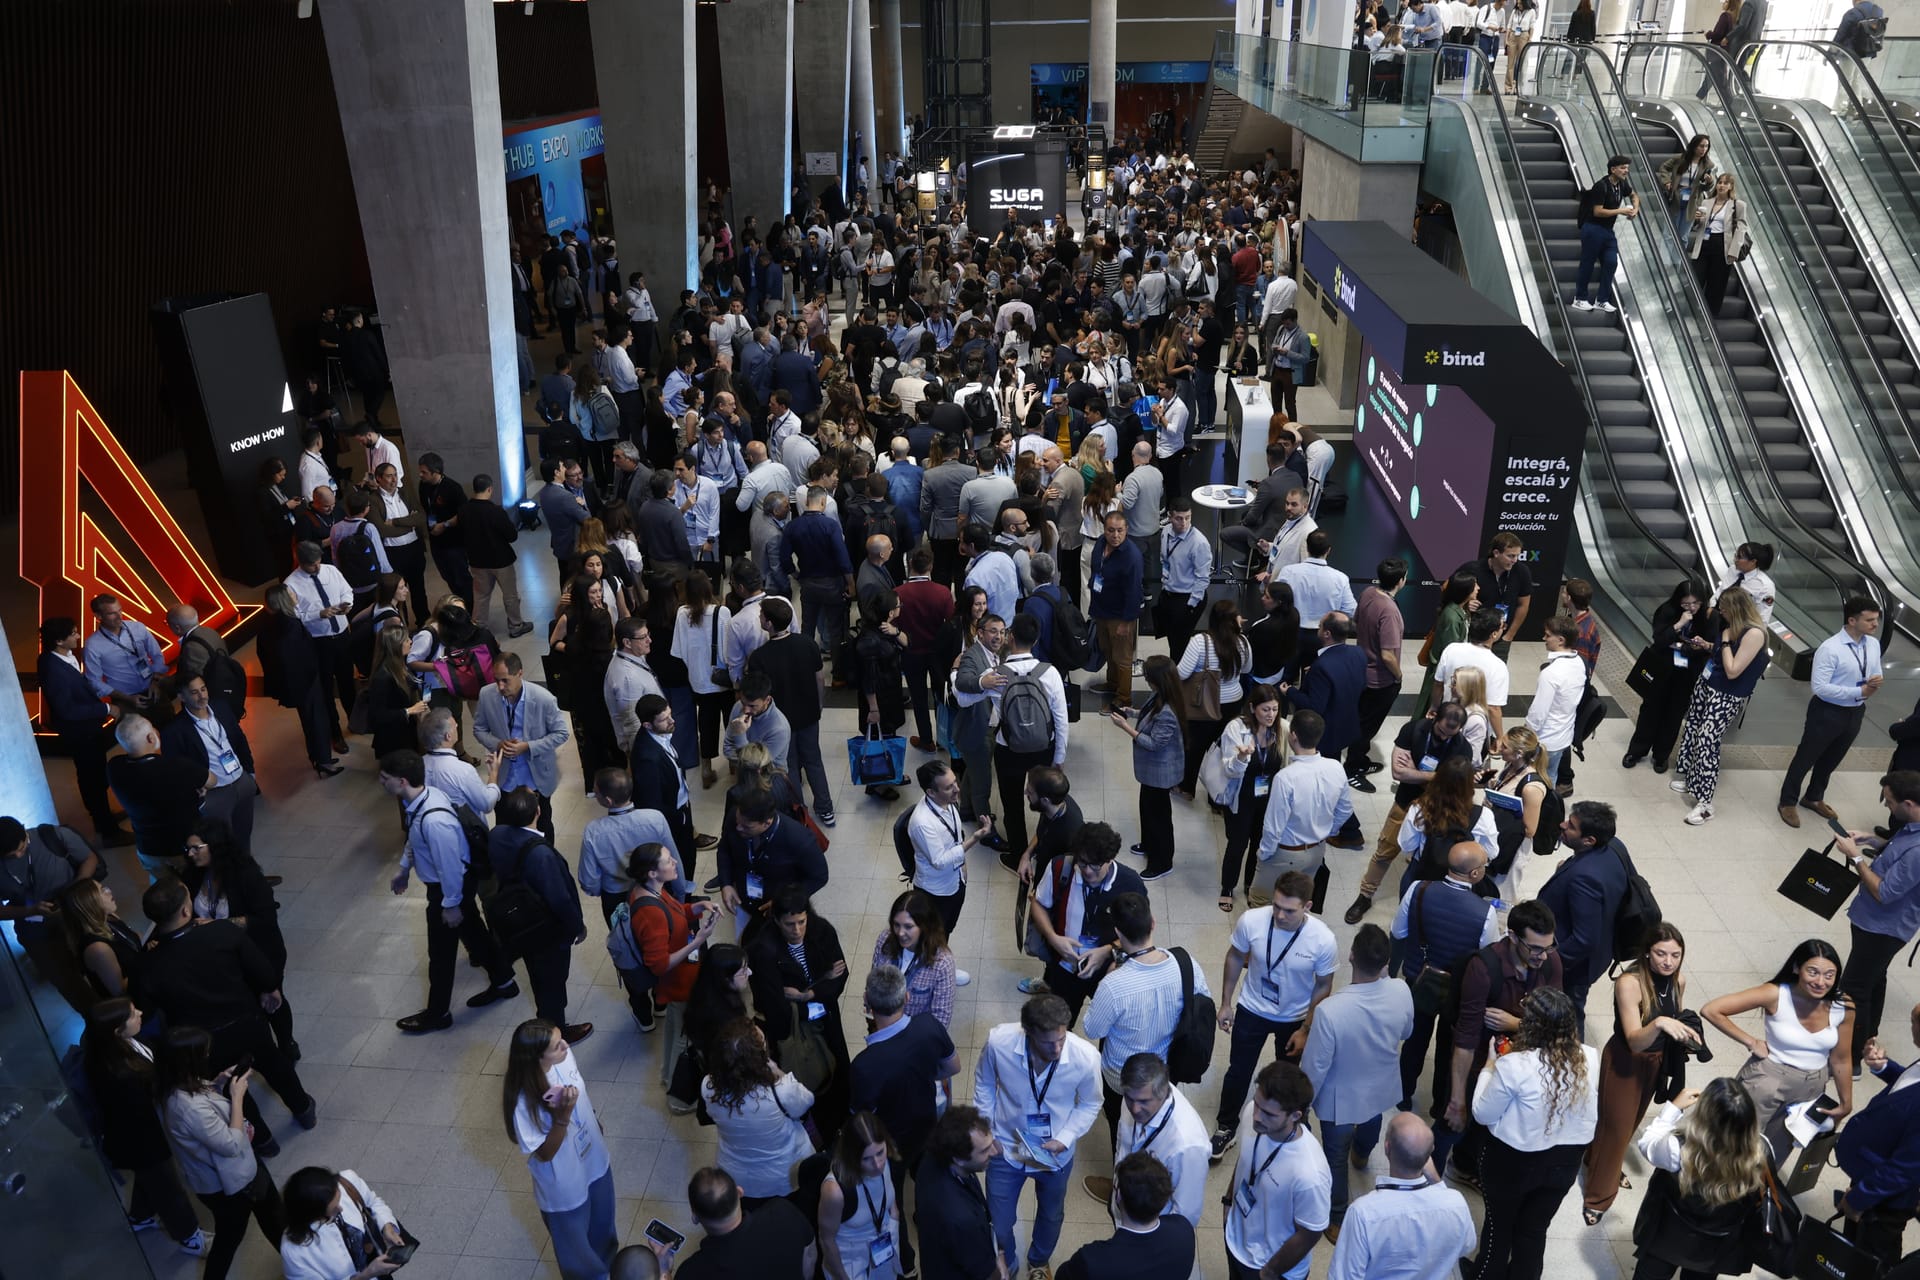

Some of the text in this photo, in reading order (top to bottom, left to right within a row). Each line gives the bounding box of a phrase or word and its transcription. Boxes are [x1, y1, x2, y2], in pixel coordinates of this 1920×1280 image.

[1061, 69, 1086, 82] VIP
[510, 144, 535, 171] HUB
[541, 134, 569, 163] EXPO
[990, 188, 1044, 202] SUGA
[1340, 274, 1356, 312] bind
[1442, 351, 1485, 367] bind
[230, 425, 285, 453] KNOW HOW
[1507, 456, 1570, 472] Integrá,
[1505, 474, 1570, 489] escalá y
[1502, 492, 1550, 503] crece.
[1500, 511, 1559, 521] Socios de tu
[1498, 522, 1547, 531] evolución.
[1825, 1260, 1846, 1279] bind
